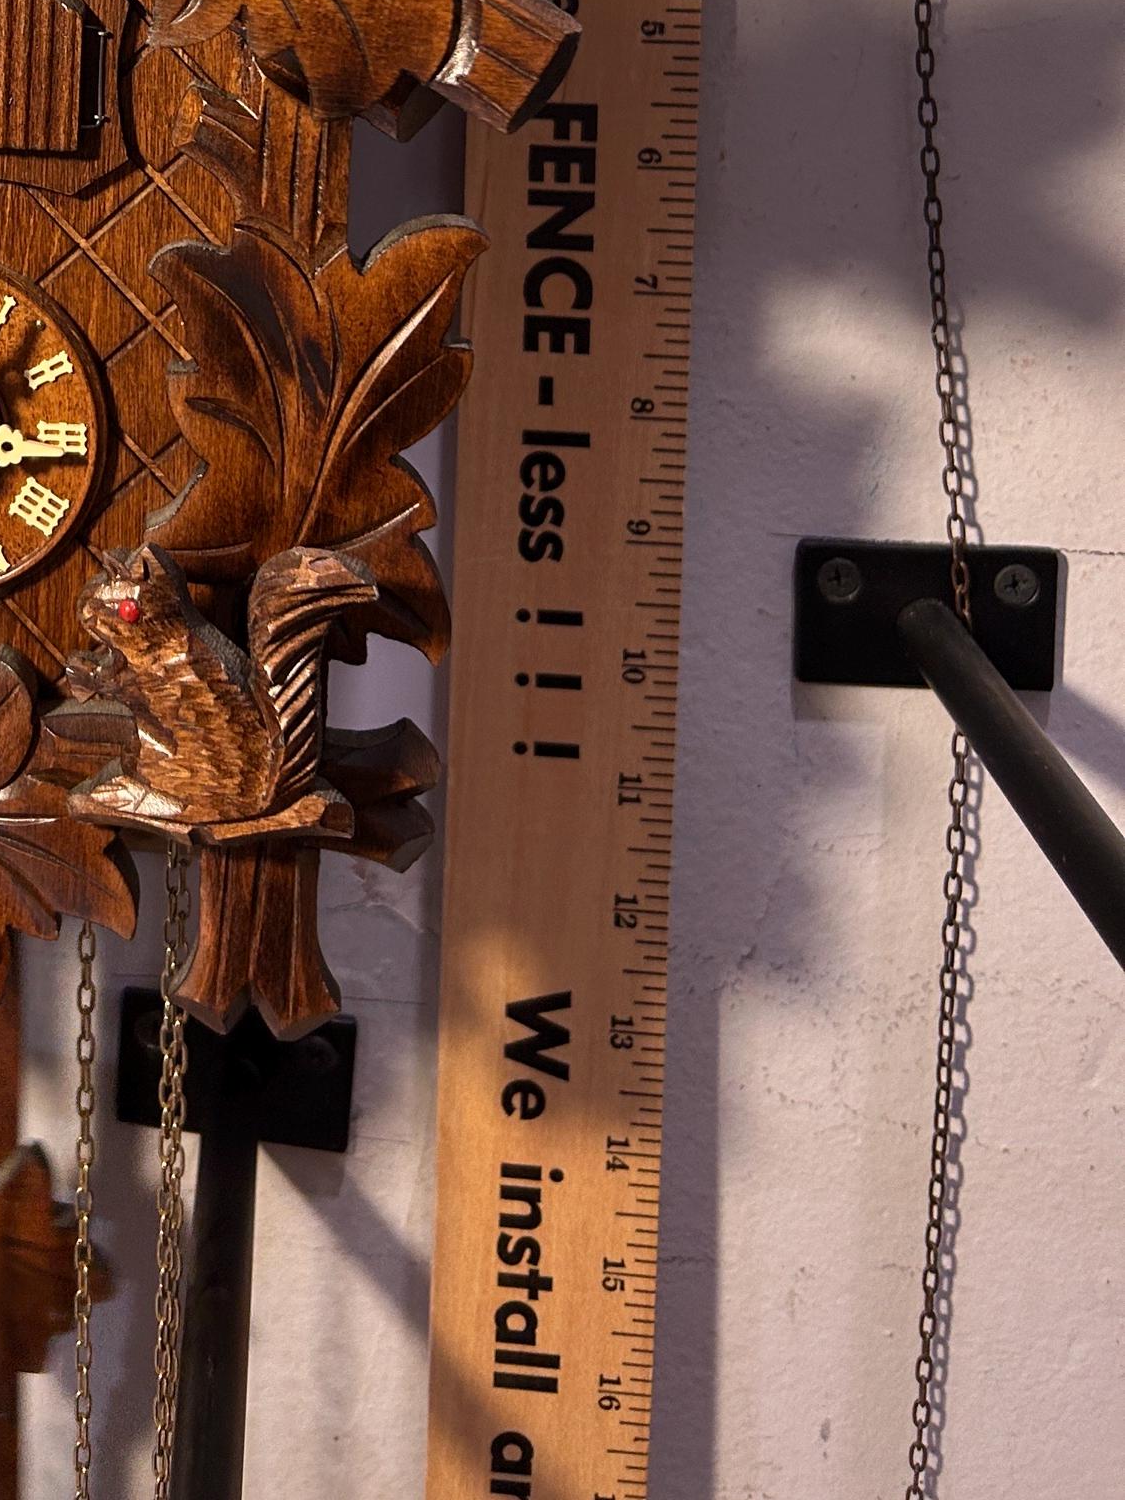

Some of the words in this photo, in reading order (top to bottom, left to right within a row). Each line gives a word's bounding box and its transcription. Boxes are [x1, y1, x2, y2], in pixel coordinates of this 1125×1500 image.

[641, 20, 665, 37] 5
[637, 148, 662, 165] 6
[635, 274, 658, 290] 7
[25, 350, 73, 390] II
[631, 397, 655, 414] 8
[627, 519, 651, 536] 9
[622, 648, 646, 684] 10
[618, 772, 641, 806] 11
[614, 893, 638, 929] 12
[610, 1014, 634, 1050] 13
[501, 990, 572, 1120] We
[606, 1135, 630, 1171] 14
[493, 1162, 564, 1394] install
[602, 1256, 625, 1292] 15
[598, 1373, 621, 1410] 16
